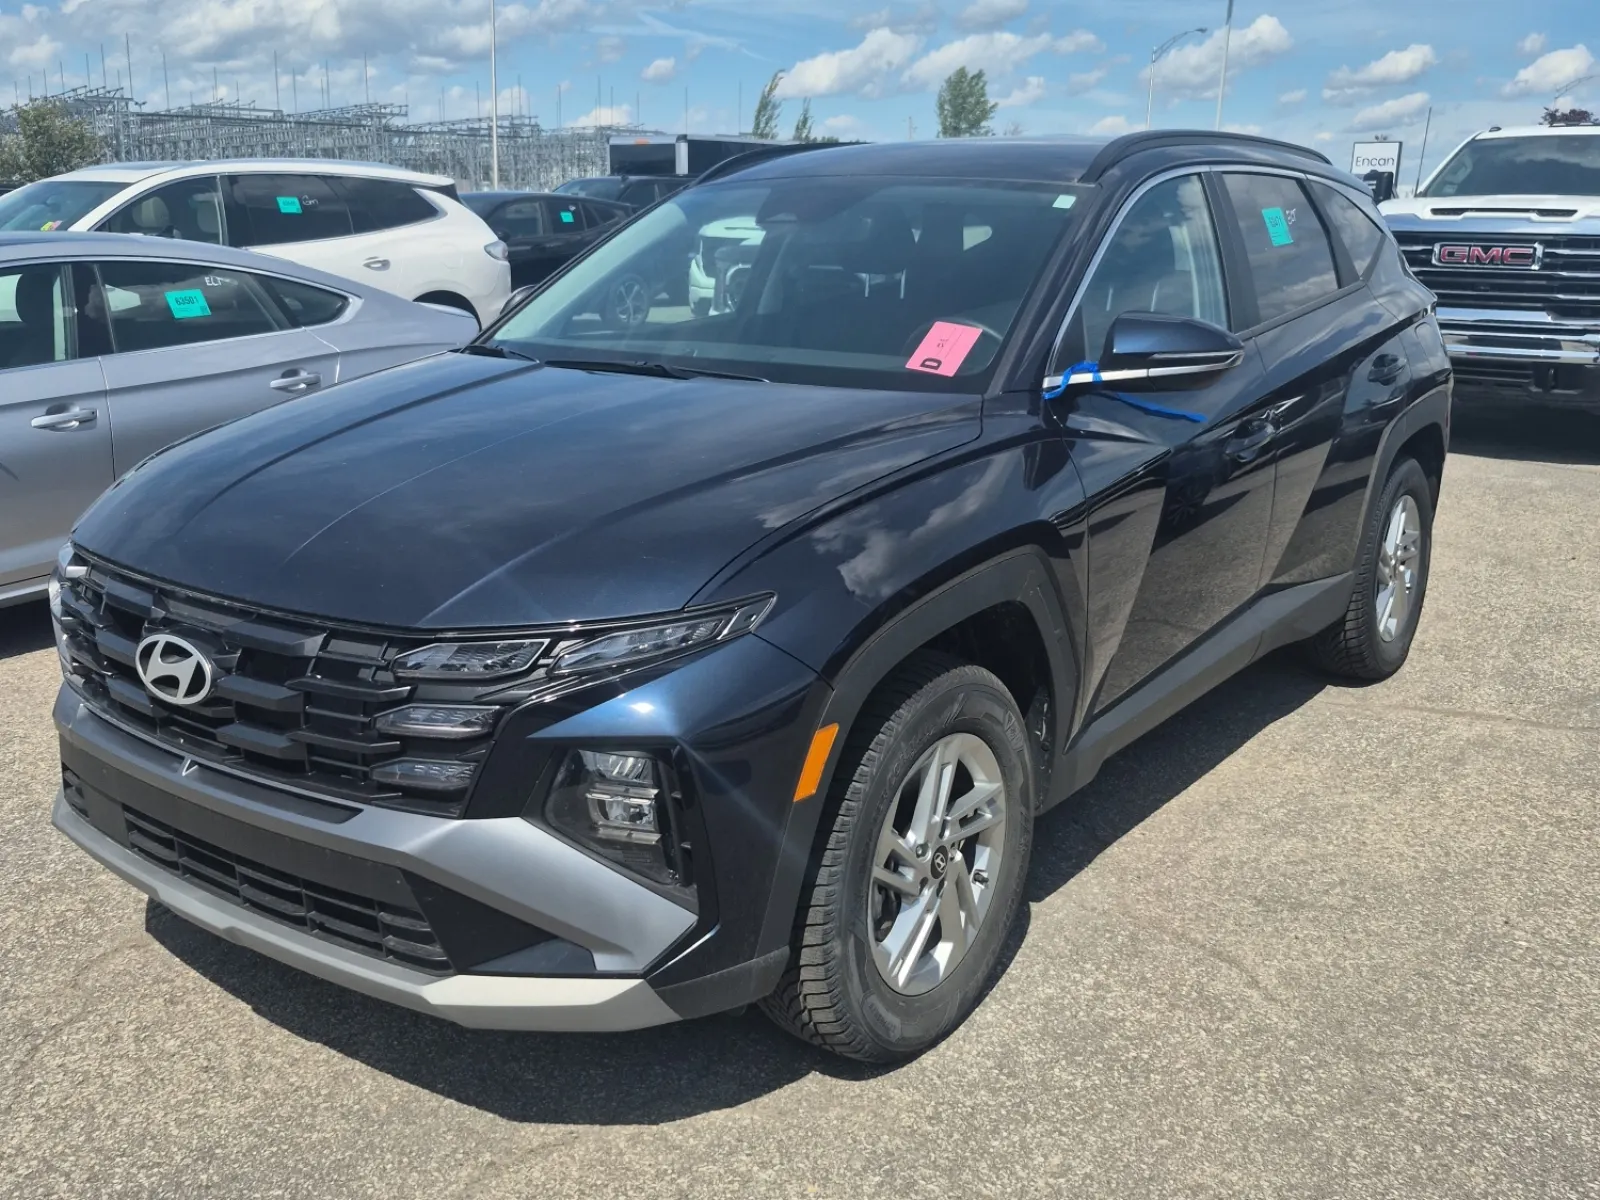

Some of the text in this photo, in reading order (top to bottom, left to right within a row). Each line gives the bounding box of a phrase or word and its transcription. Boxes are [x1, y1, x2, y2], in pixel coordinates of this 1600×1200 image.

[1355, 156, 1395, 167] Encan
[1440, 245, 1534, 265] GMC
[920, 357, 943, 371] D
